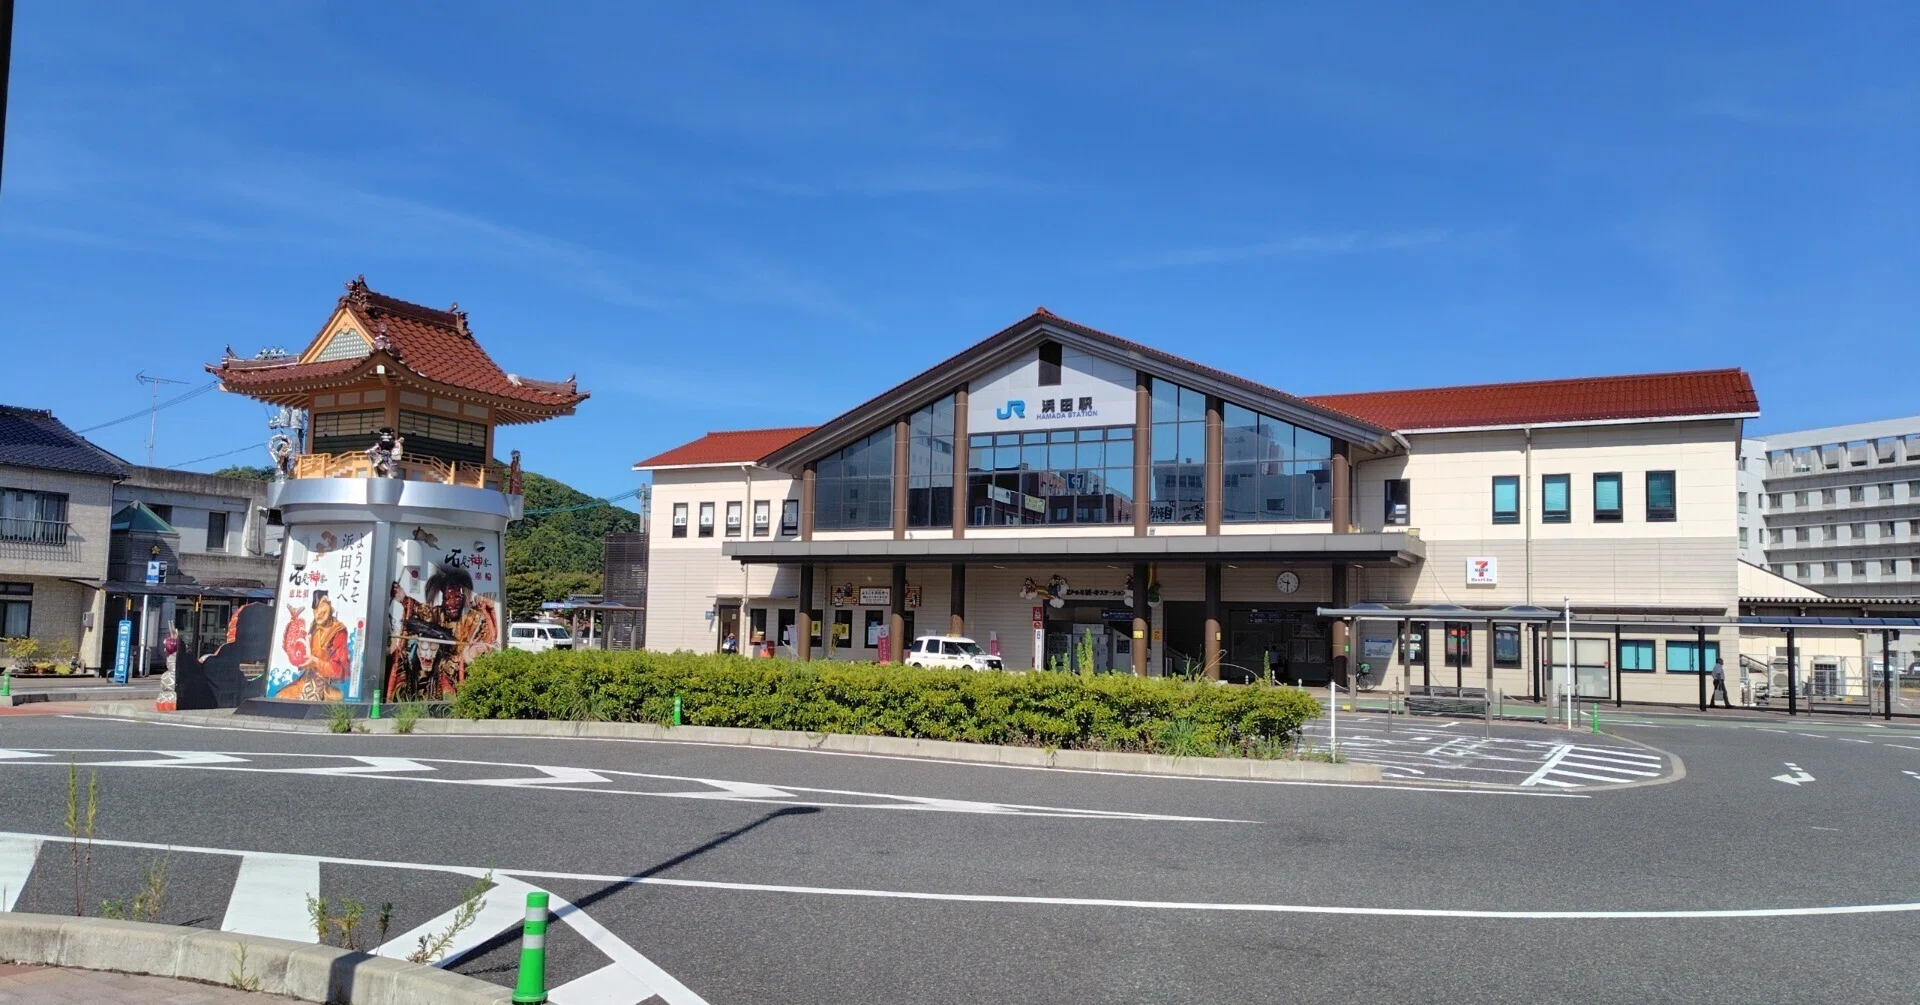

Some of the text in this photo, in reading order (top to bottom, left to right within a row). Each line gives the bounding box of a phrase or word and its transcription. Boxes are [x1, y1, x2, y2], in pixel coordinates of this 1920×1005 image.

[996, 400, 1026, 420] JR
[1036, 410, 1098, 420] HAMADA STATION
[1042, 397, 1092, 413] 浜田駅
[337, 533, 354, 602] 浜田市へ
[350, 533, 365, 603] ようこそ
